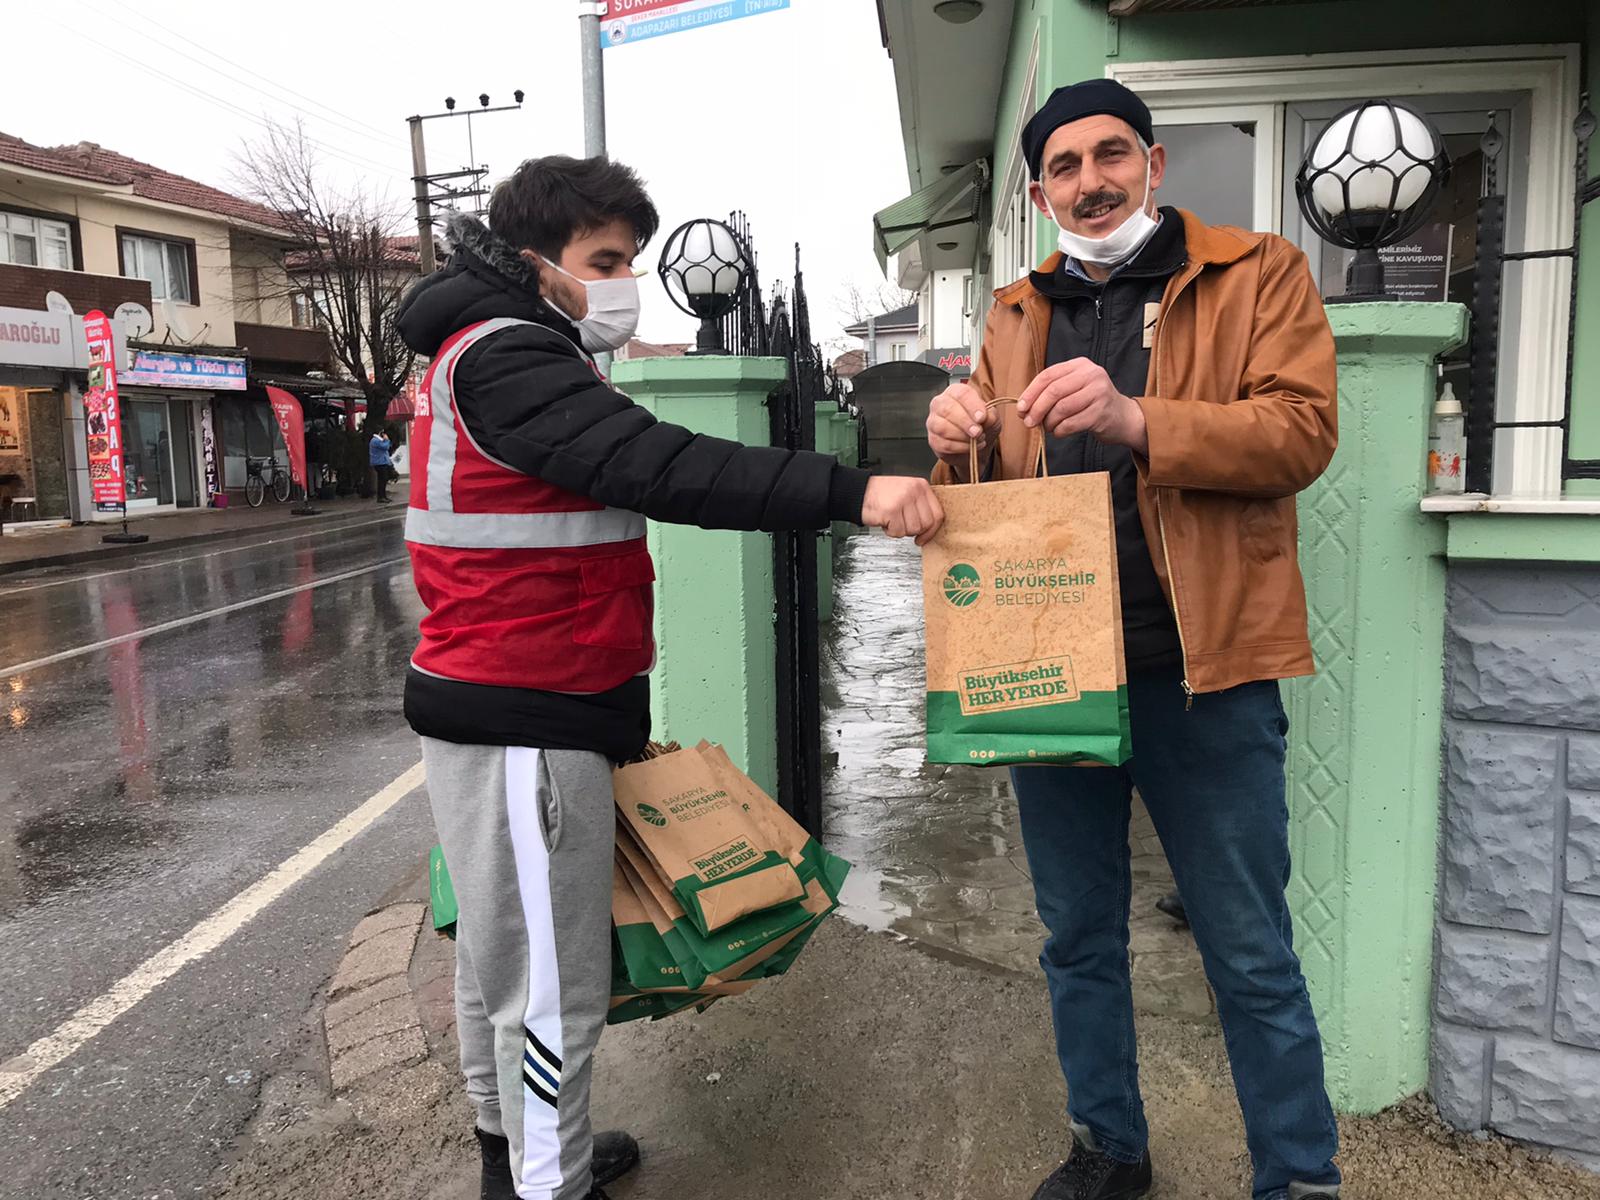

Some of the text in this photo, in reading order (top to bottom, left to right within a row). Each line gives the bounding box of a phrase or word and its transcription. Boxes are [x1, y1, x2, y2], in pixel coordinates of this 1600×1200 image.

[1396, 255, 1443, 263] KAVUŞUYOR
[994, 557, 1067, 573] SAKARYA
[995, 571, 1096, 589] BÜYÜKŞEHİR
[968, 680, 1068, 707] HER YERDE
[662, 786, 707, 807] SAKARYA
[703, 848, 758, 880] HER YERDE
